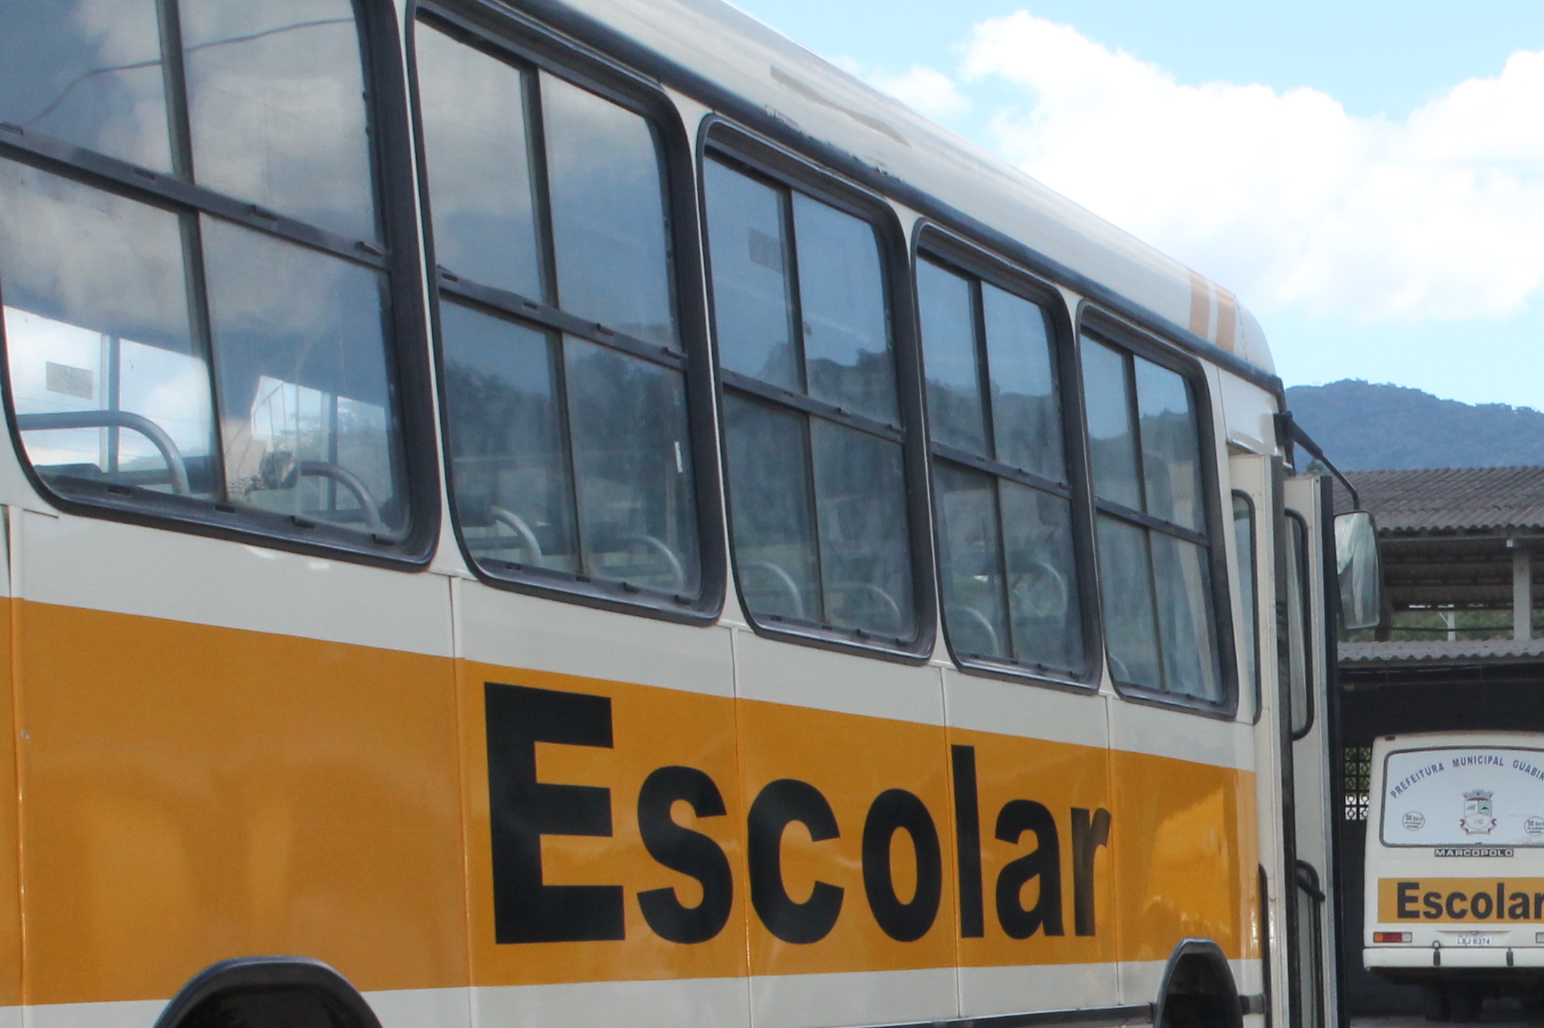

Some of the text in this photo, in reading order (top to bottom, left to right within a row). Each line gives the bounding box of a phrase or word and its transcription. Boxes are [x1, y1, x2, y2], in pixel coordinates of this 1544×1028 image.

[1390, 762, 1444, 798] PREFEITURA
[1452, 755, 1504, 768] MUNICIPAL
[483, 682, 1111, 944] Escolar
[1435, 849, 1513, 857] MARCOPOLO
